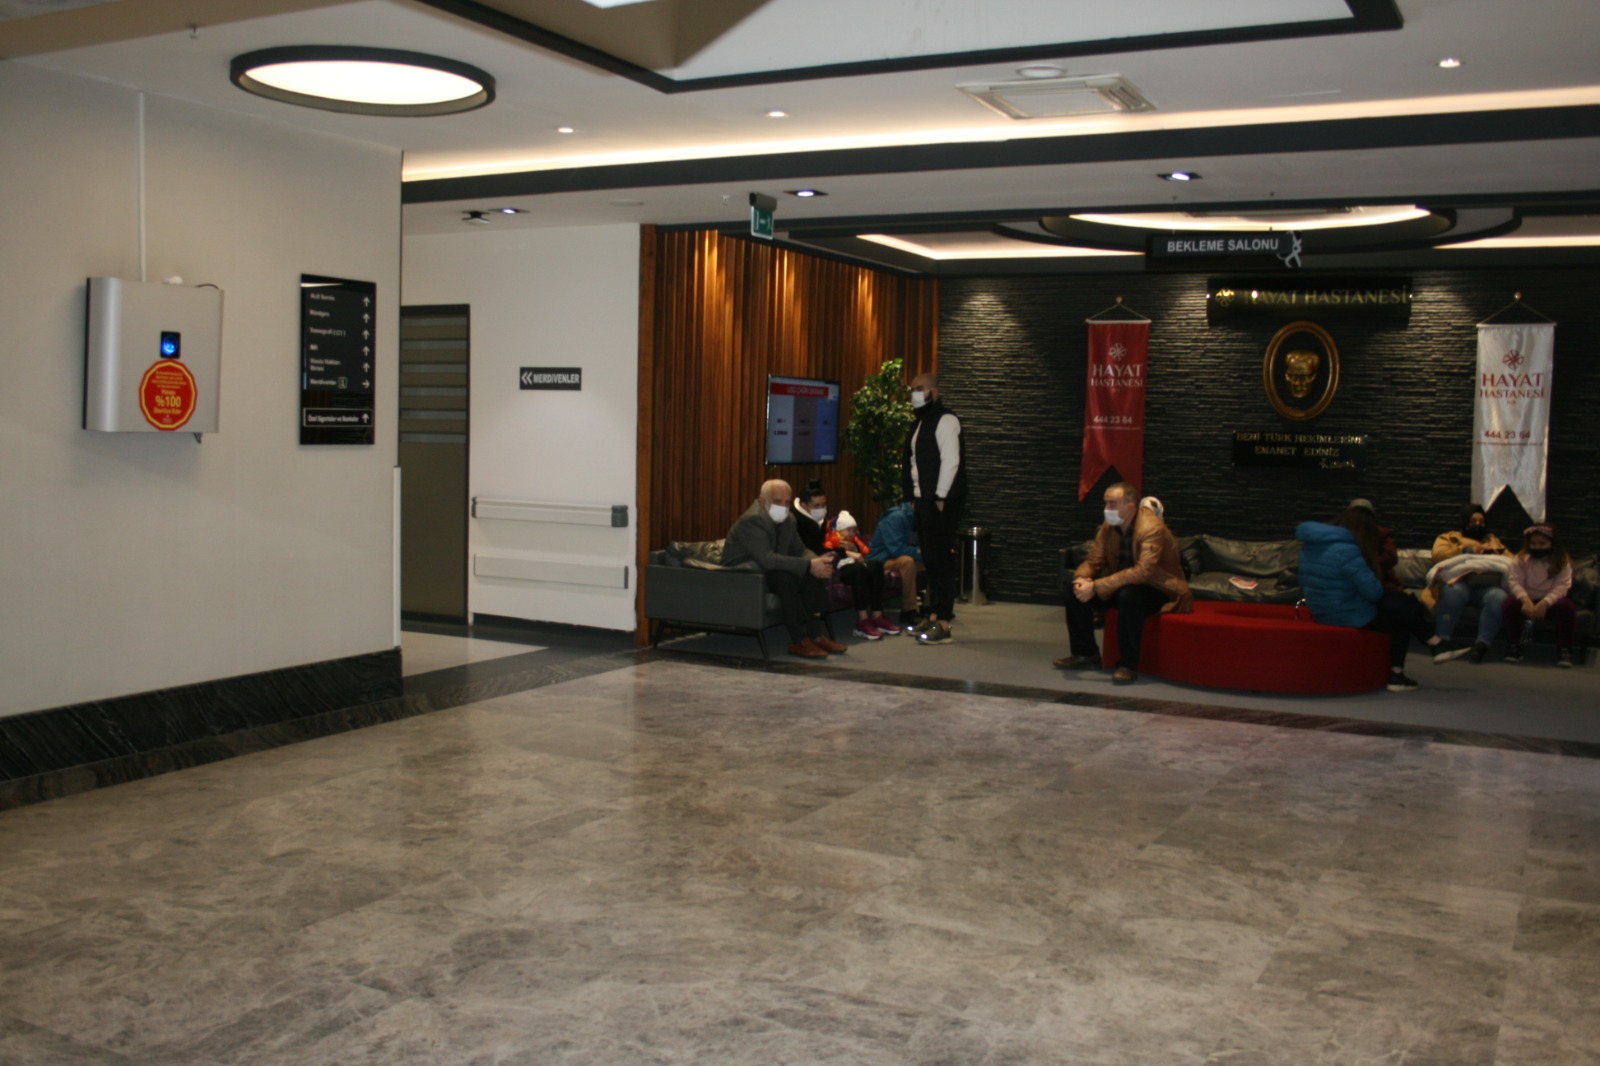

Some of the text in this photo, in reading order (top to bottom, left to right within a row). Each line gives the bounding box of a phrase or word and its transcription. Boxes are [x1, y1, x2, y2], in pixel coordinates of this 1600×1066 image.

[1166, 239, 1279, 252] BEKLEME SALONU
[1304, 285, 1407, 304] HASTANESİ
[1092, 363, 1144, 377] HAYAT
[1091, 377, 1144, 388] HASTANESİ
[1482, 373, 1544, 387] HAYAT
[1479, 387, 1545, 398] HASTANESİ
[155, 395, 182, 407] %100
[1093, 415, 1109, 424] 444
[1110, 415, 1120, 424] 23
[1263, 432, 1293, 443] TÜRK
[1484, 430, 1501, 438] 444
[1504, 431, 1516, 439] 23
[1255, 446, 1297, 456] EMANET
